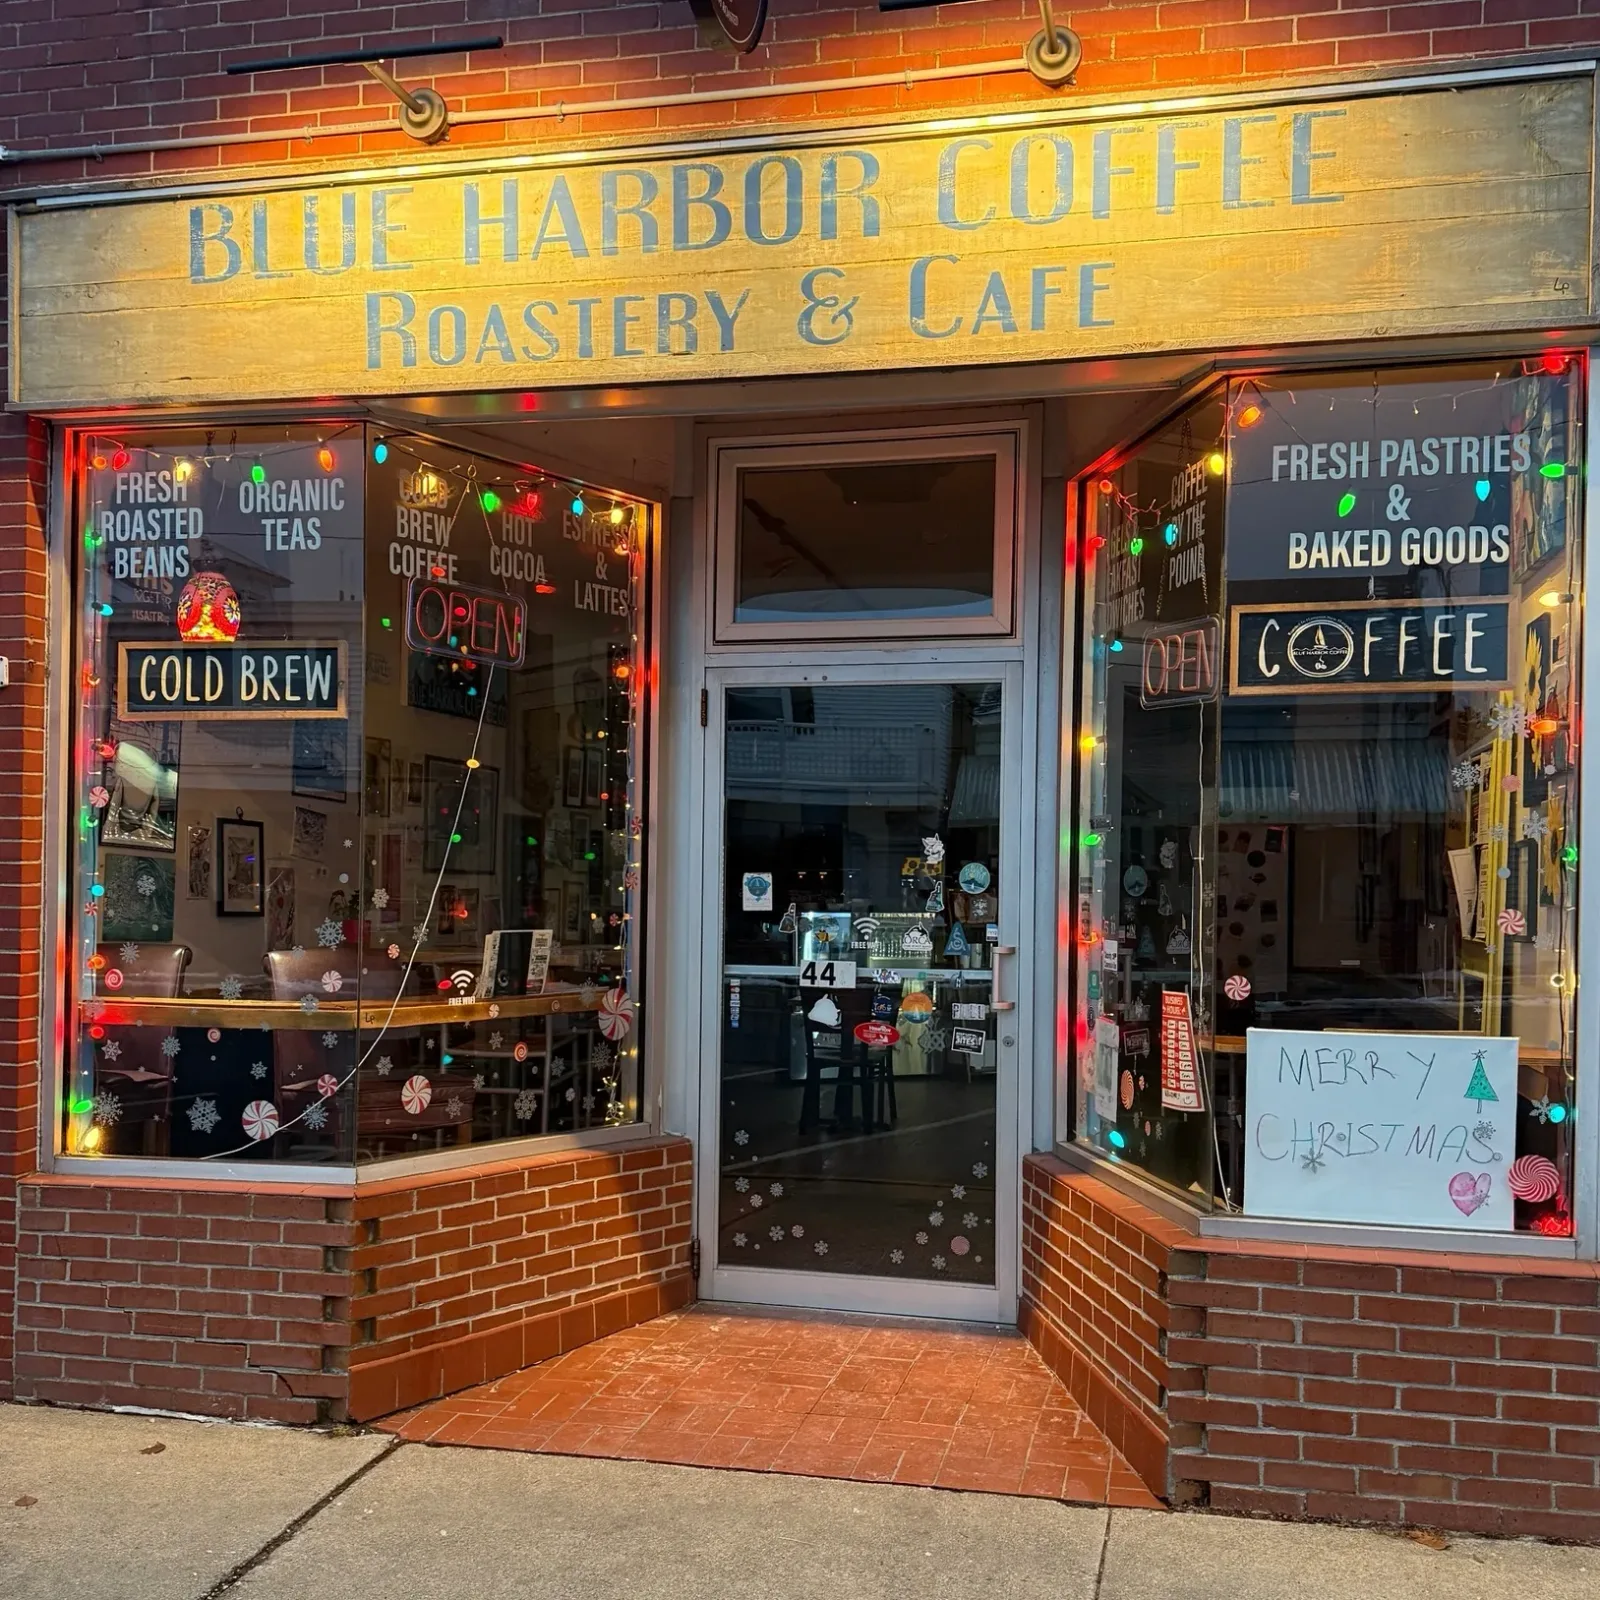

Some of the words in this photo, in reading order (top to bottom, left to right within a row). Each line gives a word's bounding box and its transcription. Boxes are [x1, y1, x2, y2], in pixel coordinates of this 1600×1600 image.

[189, 187, 413, 284] BLUE
[463, 150, 881, 266] HARBOR
[936, 108, 1347, 231] COFFEE
[364, 288, 751, 370] ROASTERY
[796, 267, 860, 345] &
[908, 253, 1116, 339] CAFE
[1271, 440, 1370, 482] FRESH
[1379, 433, 1532, 477] PASTRIES
[115, 469, 188, 504] FRESH
[239, 477, 345, 514] ORGANIC
[1385, 484, 1412, 521] &
[101, 507, 204, 542] ROASTED
[261, 517, 322, 551] TEAS
[396, 505, 452, 548] BREW
[502, 511, 536, 547] HOT
[562, 509, 634, 554] ESPRESS
[1186, 501, 1206, 543] THE
[114, 545, 190, 579] BEANS
[389, 542, 459, 585] COFFEE
[489, 545, 547, 583] COCOA
[595, 551, 608, 581] &
[1288, 528, 1392, 569] BAKED
[1400, 524, 1510, 567] GOODS
[1168, 543, 1207, 592] POUND
[574, 580, 629, 618] LATTES
[415, 586, 521, 657] OPEN
[140, 655, 223, 701] COLD
[240, 655, 332, 701] BREW
[1145, 628, 1216, 695] OPEN
[851, 941, 866, 949] FREE
[904, 936, 931, 945] ORCA
[801, 961, 836, 986] 44
[448, 997, 463, 1006] FREE
[1278, 1046, 1436, 1100] MERRY
[1255, 1113, 1495, 1165] CHRISTMAS
